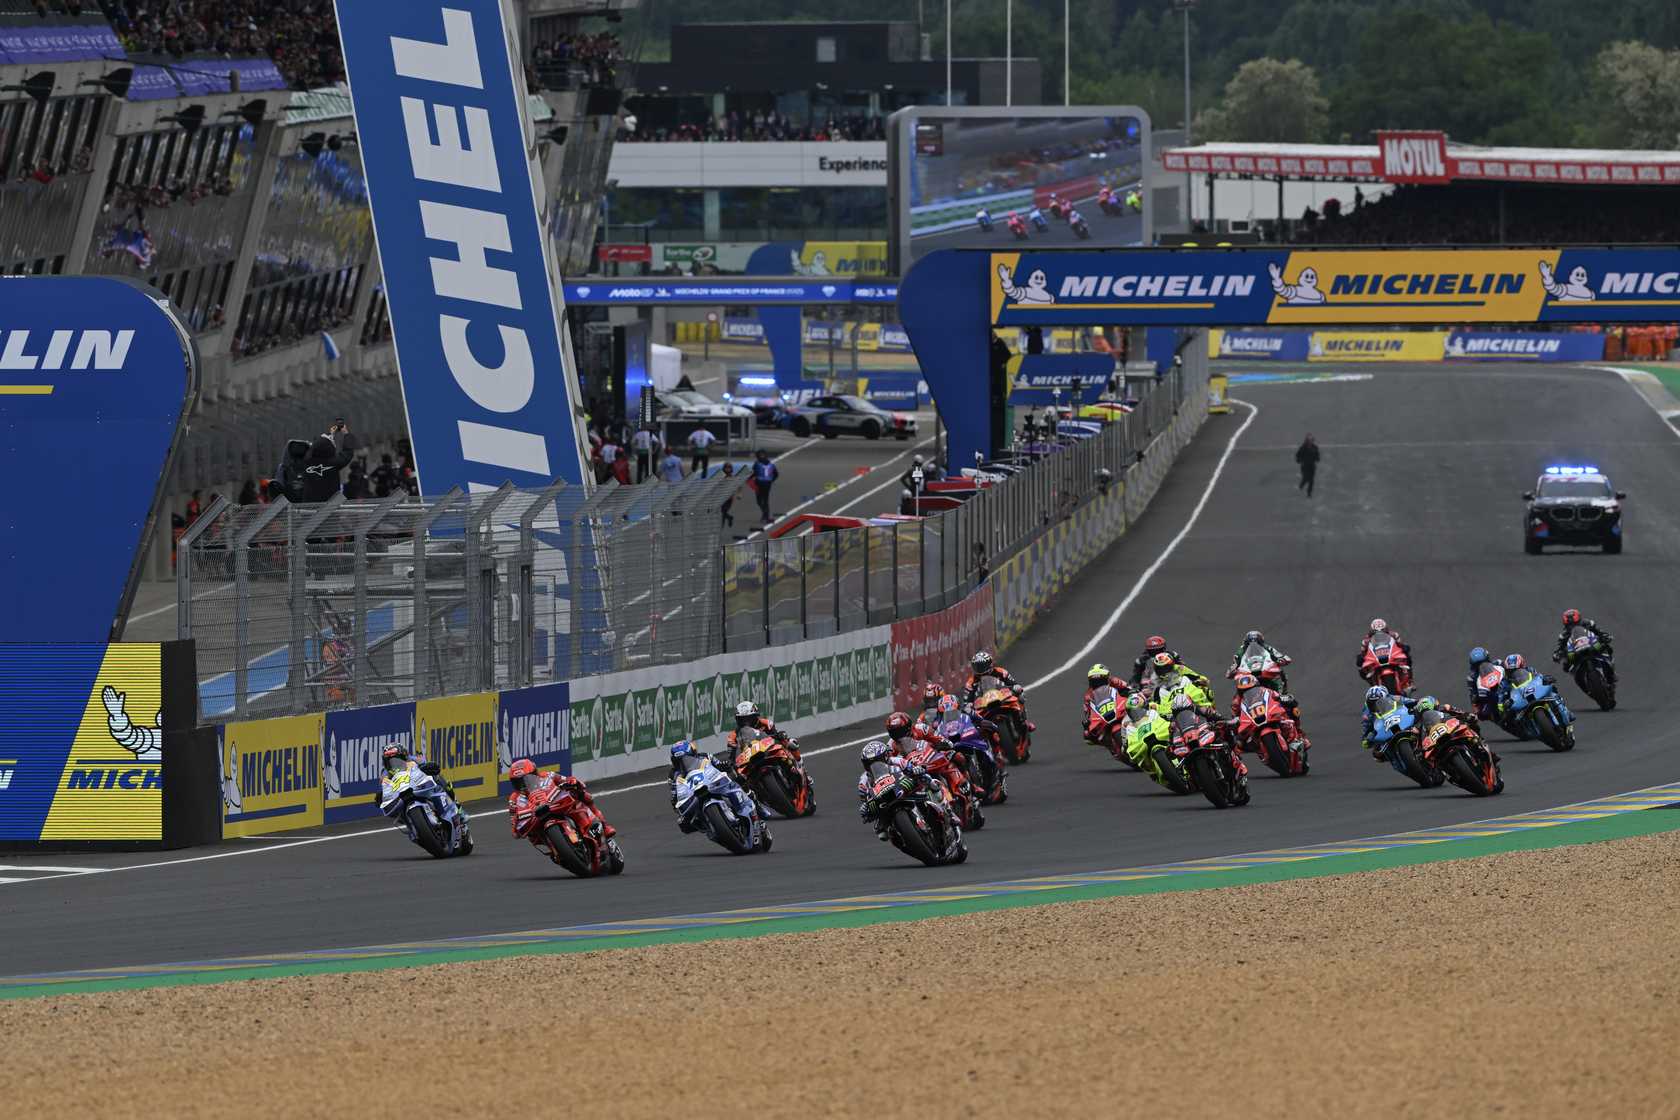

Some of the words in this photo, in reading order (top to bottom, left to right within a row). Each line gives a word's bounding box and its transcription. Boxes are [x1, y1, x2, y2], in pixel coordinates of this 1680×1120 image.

[1383, 138, 1446, 176] MOTUL
[1059, 275, 1255, 297] MICHELIN
[1330, 273, 1526, 295] MICHELIN
[1600, 272, 1680, 294] MIC
[1325, 339, 1404, 352] MICHELIN
[1466, 339, 1560, 353] MICHELIN
[1032, 374, 1107, 386] MICHLIN
[512, 708, 570, 758] MICHELIN
[430, 721, 494, 770] MICHELIN
[242, 744, 319, 798] MICHELIN
